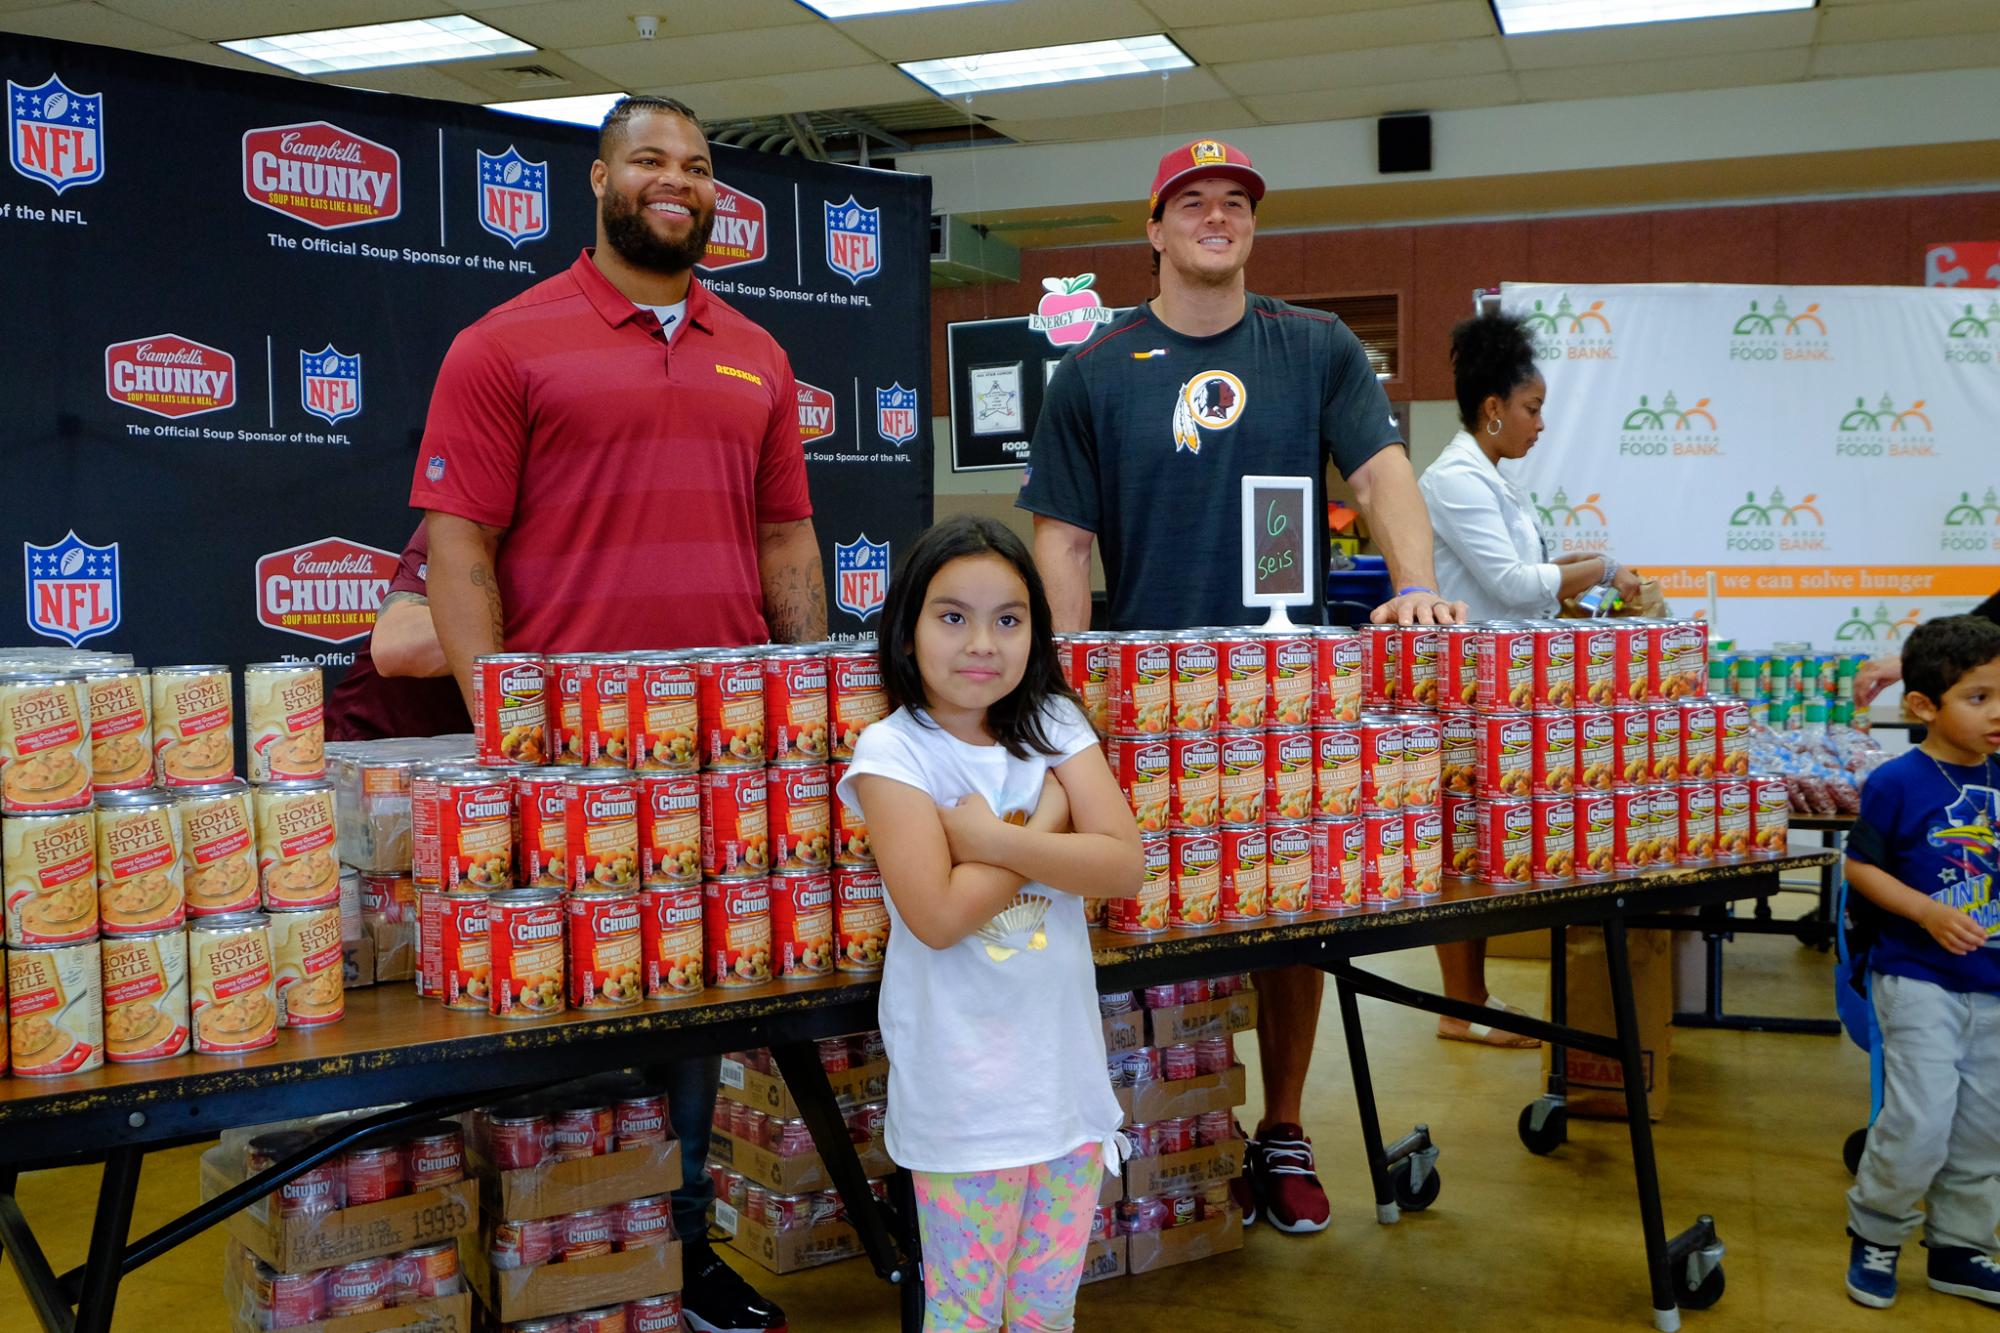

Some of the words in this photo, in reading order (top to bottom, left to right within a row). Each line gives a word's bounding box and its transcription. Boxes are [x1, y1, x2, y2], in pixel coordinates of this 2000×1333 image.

[20, 123, 94, 178] NFL
[280, 132, 362, 163] Campbell's
[252, 150, 392, 207] CHUNKY
[268, 191, 289, 205] SOUP
[290, 195, 309, 208] THAT
[310, 198, 328, 210] EATS
[329, 202, 346, 212] LIKE
[347, 203, 352, 213] A
[353, 204, 373, 215] MEAL
[486, 188, 542, 231] NFL
[715, 192, 737, 213] bell's
[15, 204, 46, 221] the
[51, 208, 88, 225] NFL
[267, 233, 297, 249] The
[301, 237, 357, 255] Official
[361, 244, 398, 261] Soup
[402, 248, 461, 266] Sponsor
[464, 255, 480, 267] of
[482, 256, 505, 271] the
[509, 260, 536, 274] NFL
[714, 245, 726, 255] LIKE
[731, 247, 746, 258] MEAL
[833, 232, 875, 271] NFL
[737, 283, 766, 298] Soup
[769, 286, 814, 301] Sponsor
[816, 291, 829, 303] of
[830, 293, 848, 305] the
[850, 295, 872, 307] NFL
[1033, 311, 1075, 329] ENERGY
[1082, 307, 1110, 322] ZONE
[136, 343, 203, 366] Campbell's
[1567, 346, 1612, 361] BANK
[1729, 347, 1778, 361] FOOD
[1782, 347, 1829, 361] BANK
[1944, 350, 1991, 364] FOOD
[113, 360, 228, 399] CHUNKY
[127, 392, 144, 402] SOUP
[145, 393, 160, 402] THAT
[161, 394, 176, 404] EATS
[177, 395, 190, 404] LIKE
[307, 377, 355, 412] NFL
[126, 424, 151, 436] The
[154, 425, 199, 438] Official
[203, 428, 235, 441] Soup
[237, 430, 286, 443] Sponsor
[289, 432, 303, 443] of
[305, 433, 324, 444] the
[327, 434, 351, 445] NFL
[882, 410, 913, 437] NFL
[1002, 441, 1029, 452] FOOD
[1619, 442, 1667, 456] FOOD
[1673, 442, 1720, 456] BANK
[1836, 443, 1883, 457] FOOD
[1888, 443, 1934, 457] BANK
[813, 452, 834, 463] Soup
[836, 453, 868, 464] Sponsor
[870, 453, 879, 462] of
[880, 453, 893, 463] the
[894, 454, 911, 463] NFL
[1266, 499, 1288, 536] 6
[1562, 538, 1609, 551] BANK
[1727, 538, 1774, 551] FOOD
[1779, 538, 1825, 551] BANK
[1941, 537, 1987, 551] FOOD
[293, 551, 373, 578] Campbell's
[1257, 549, 1294, 581] seis
[842, 572, 884, 609] NFL
[1723, 575, 1751, 589] we
[1757, 575, 1794, 590] can
[1800, 569, 1854, 589] solve
[1860, 568, 1934, 592] hunger
[266, 574, 390, 614] CHUNK
[37, 582, 111, 632] NFL
[282, 614, 302, 625] SOUP
[303, 614, 322, 625] THAT
[323, 613, 341, 624] EATS
[342, 613, 358, 624] LIKE
[359, 613, 365, 624] A
[365, 612, 377, 623] ME
[838, 632, 856, 643] the
[858, 631, 878, 641] NFL
[281, 654, 310, 664] The
[314, 651, 356, 666] Offici
[1178, 654, 1217, 669] CHUNKY
[174, 682, 223, 705] HOME
[651, 680, 695, 698] CHUNKY
[10, 693, 68, 719] HOME
[177, 692, 225, 715] STYLE
[12, 705, 71, 731] STYLE
[1323, 743, 1360, 756] CHUNKY
[1404, 736, 1439, 749] CHUNKY
[1224, 749, 1263, 763] CHUNKY
[188, 804, 239, 832] HOME
[276, 800, 326, 825] HOME
[592, 800, 637, 819] CHUNKY
[106, 818, 161, 844] HOME
[191, 815, 243, 842] STYLE
[279, 811, 328, 836] STYLE
[33, 824, 88, 852] HOME
[109, 829, 165, 856] STYLE
[1273, 840, 1310, 852] CHUNKY
[36, 836, 90, 864] STYLE
[517, 921, 562, 941] CHUNKY
[207, 938, 262, 965] HOME
[211, 949, 265, 976] STYLE
[9, 961, 43, 979] OME
[9, 972, 48, 994] TYLE
[621, 1115, 663, 1133] CHUNKY
[418, 1152, 461, 1173] CHUNKY
[283, 1178, 331, 1199] CHUNKY
[412, 1203, 467, 1240] 19953
[627, 1215, 668, 1233] CHUNKY
[333, 1282, 378, 1298] CHUNKY
[639, 1312, 679, 1332] CHUNKY
